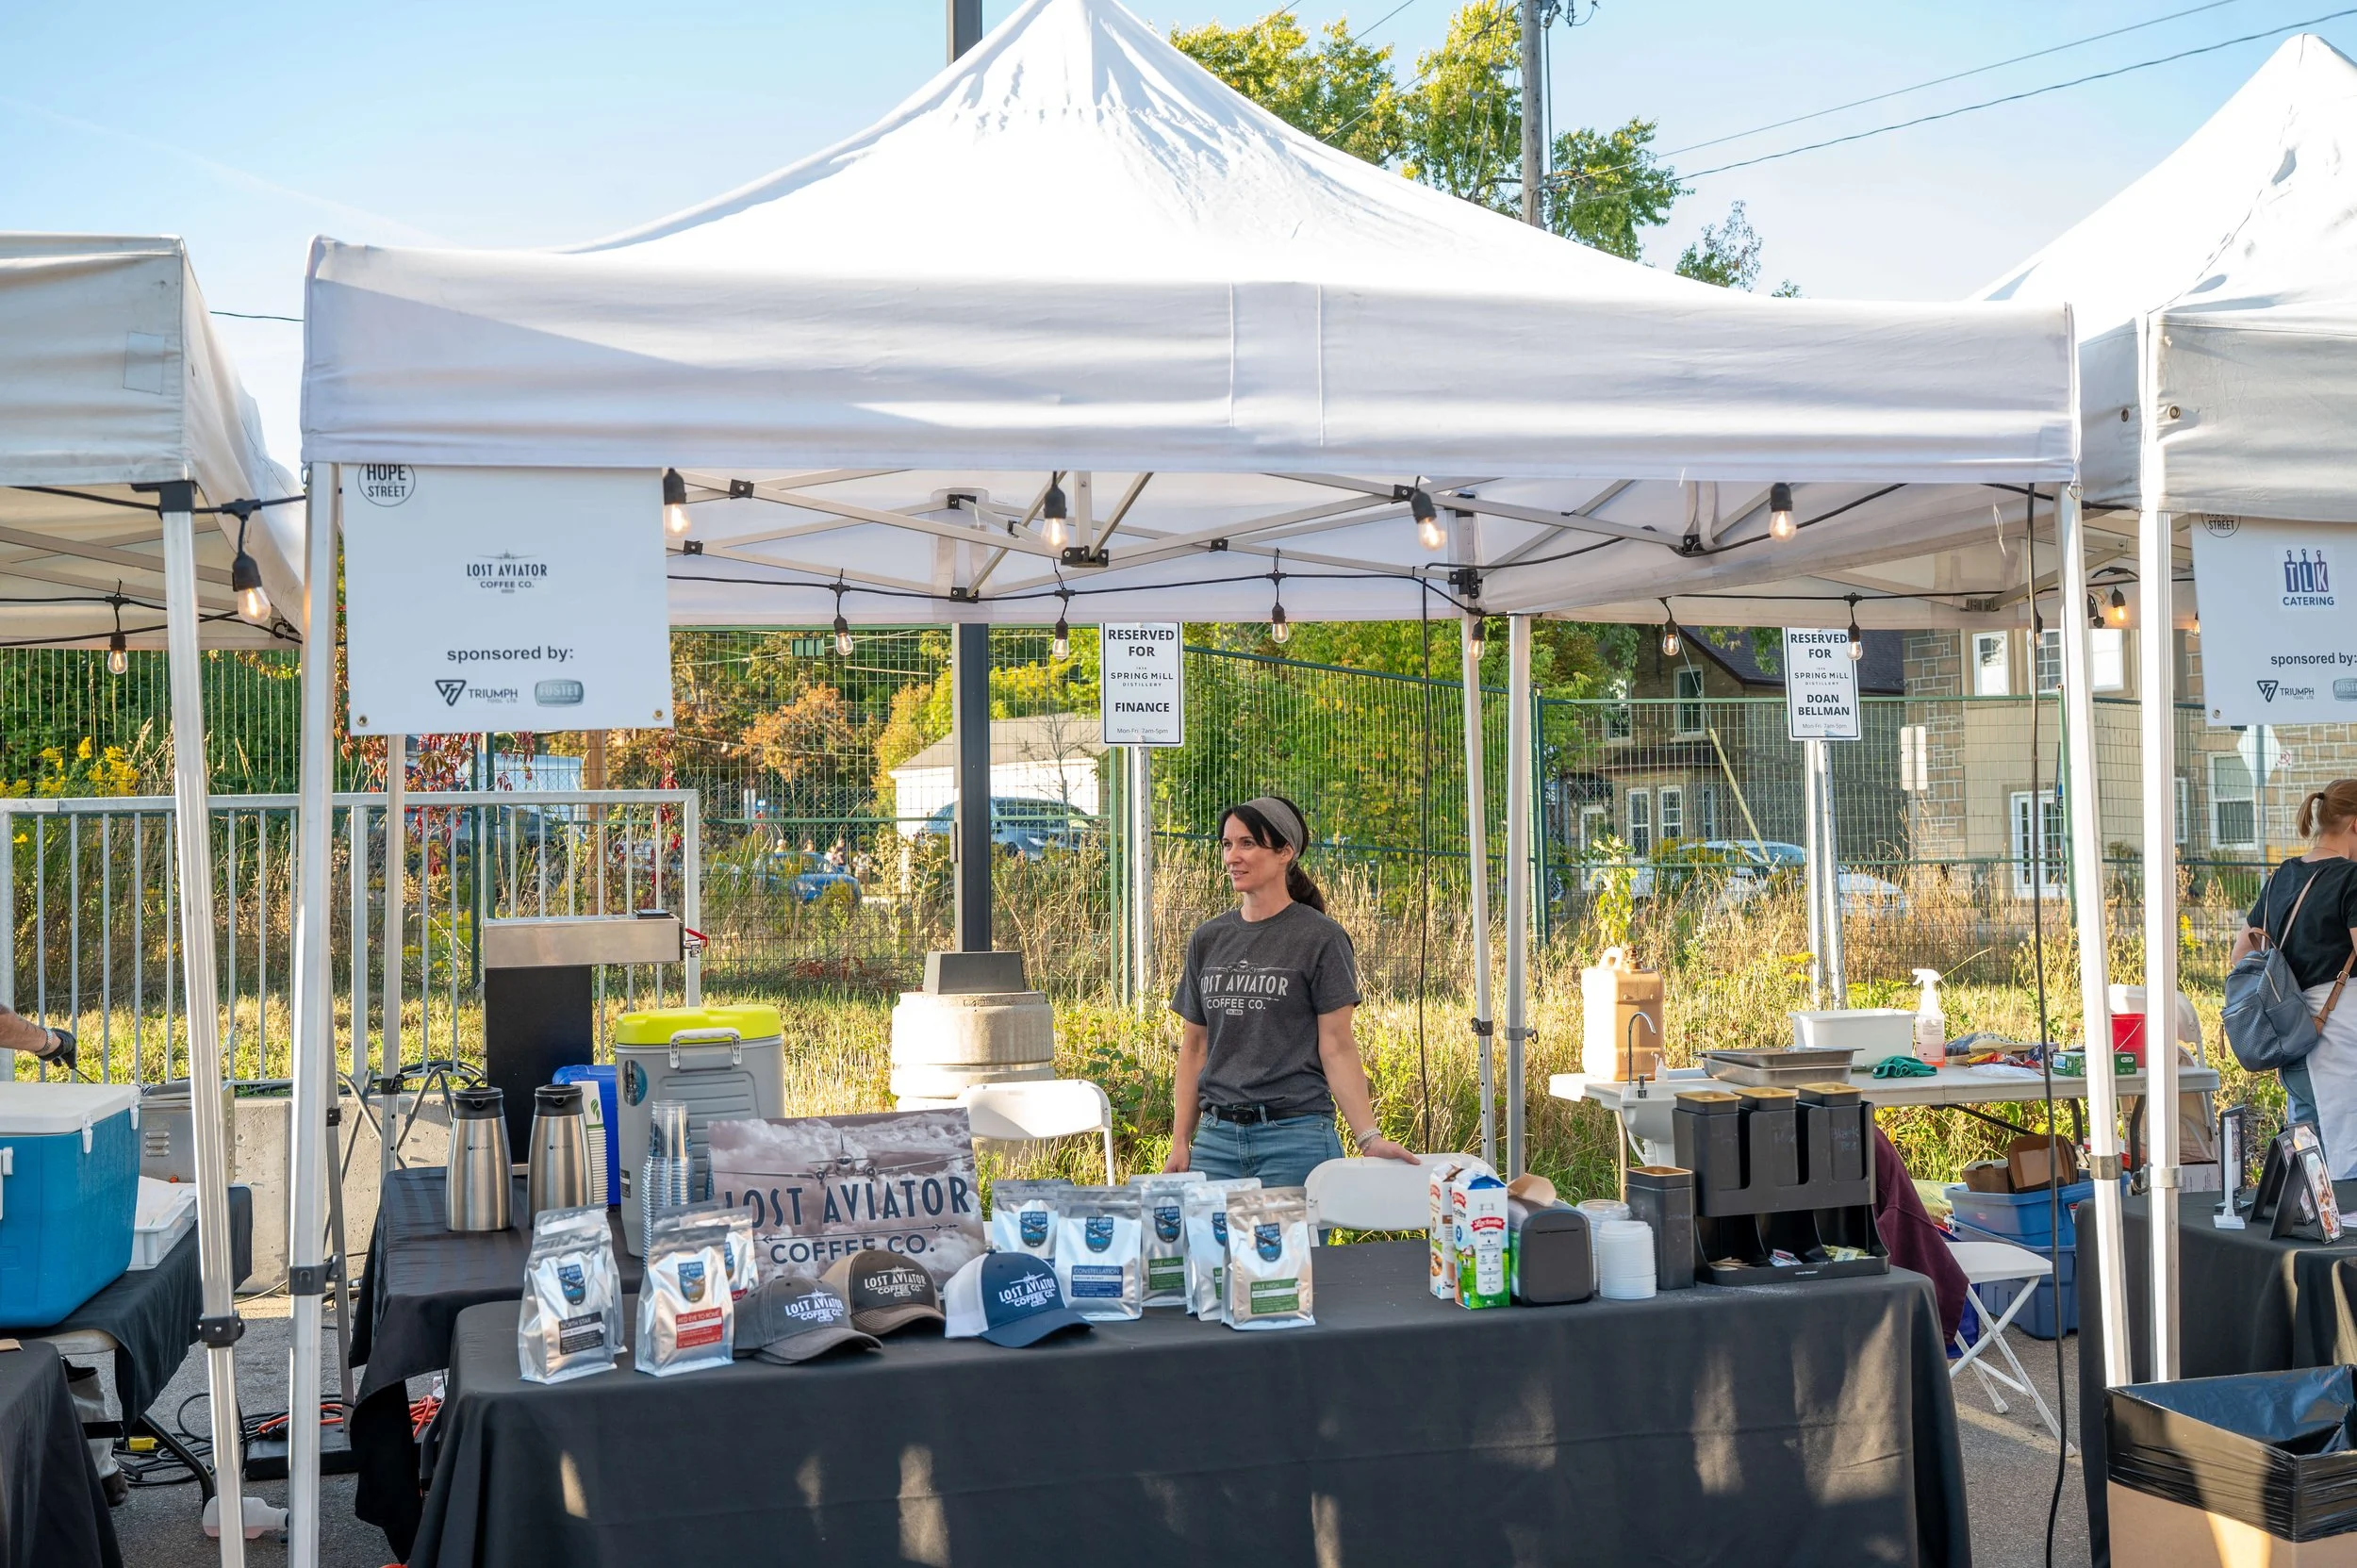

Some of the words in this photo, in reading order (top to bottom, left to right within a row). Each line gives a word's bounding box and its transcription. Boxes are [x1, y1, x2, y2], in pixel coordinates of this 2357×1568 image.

[367, 464, 406, 481] HOPE
[368, 486, 405, 497] STREET
[2208, 520, 2234, 530] STREET
[467, 564, 492, 577] LOST
[498, 564, 548, 577] AVIATOR
[2285, 564, 2329, 592] TLK
[2283, 596, 2335, 606] CATERING
[1108, 629, 1175, 640] RESERVED
[1790, 634, 1848, 644] RESERVED
[447, 646, 541, 664] sponsored
[548, 645, 574, 663] by:
[1129, 646, 1156, 657] FOR
[1808, 648, 1832, 658] FOR
[2270, 652, 2335, 668] sponsored
[468, 688, 519, 699] TRIUMPH
[2280, 687, 2315, 696] TRIUMPH
[1806, 694, 1839, 703] DOAN
[1114, 702, 1170, 713] FINANCE
[1798, 706, 1850, 716] BELLMAN
[1226, 974, 1289, 996] AVIATOR
[1207, 998, 1244, 1009] COFFEE
[1247, 999, 1266, 1010] CO.
[823, 1177, 971, 1224] AVIATOR
[887, 1234, 935, 1254] CO.
[864, 1275, 887, 1289] LOST
[892, 1273, 927, 1285] AVIATOR
[878, 1284, 909, 1295] COFFEE
[998, 1285, 1023, 1302] LOST
[1026, 1278, 1056, 1295] AVIATOR
[784, 1300, 810, 1316] LOST
[814, 1297, 844, 1310] AVIATOR
